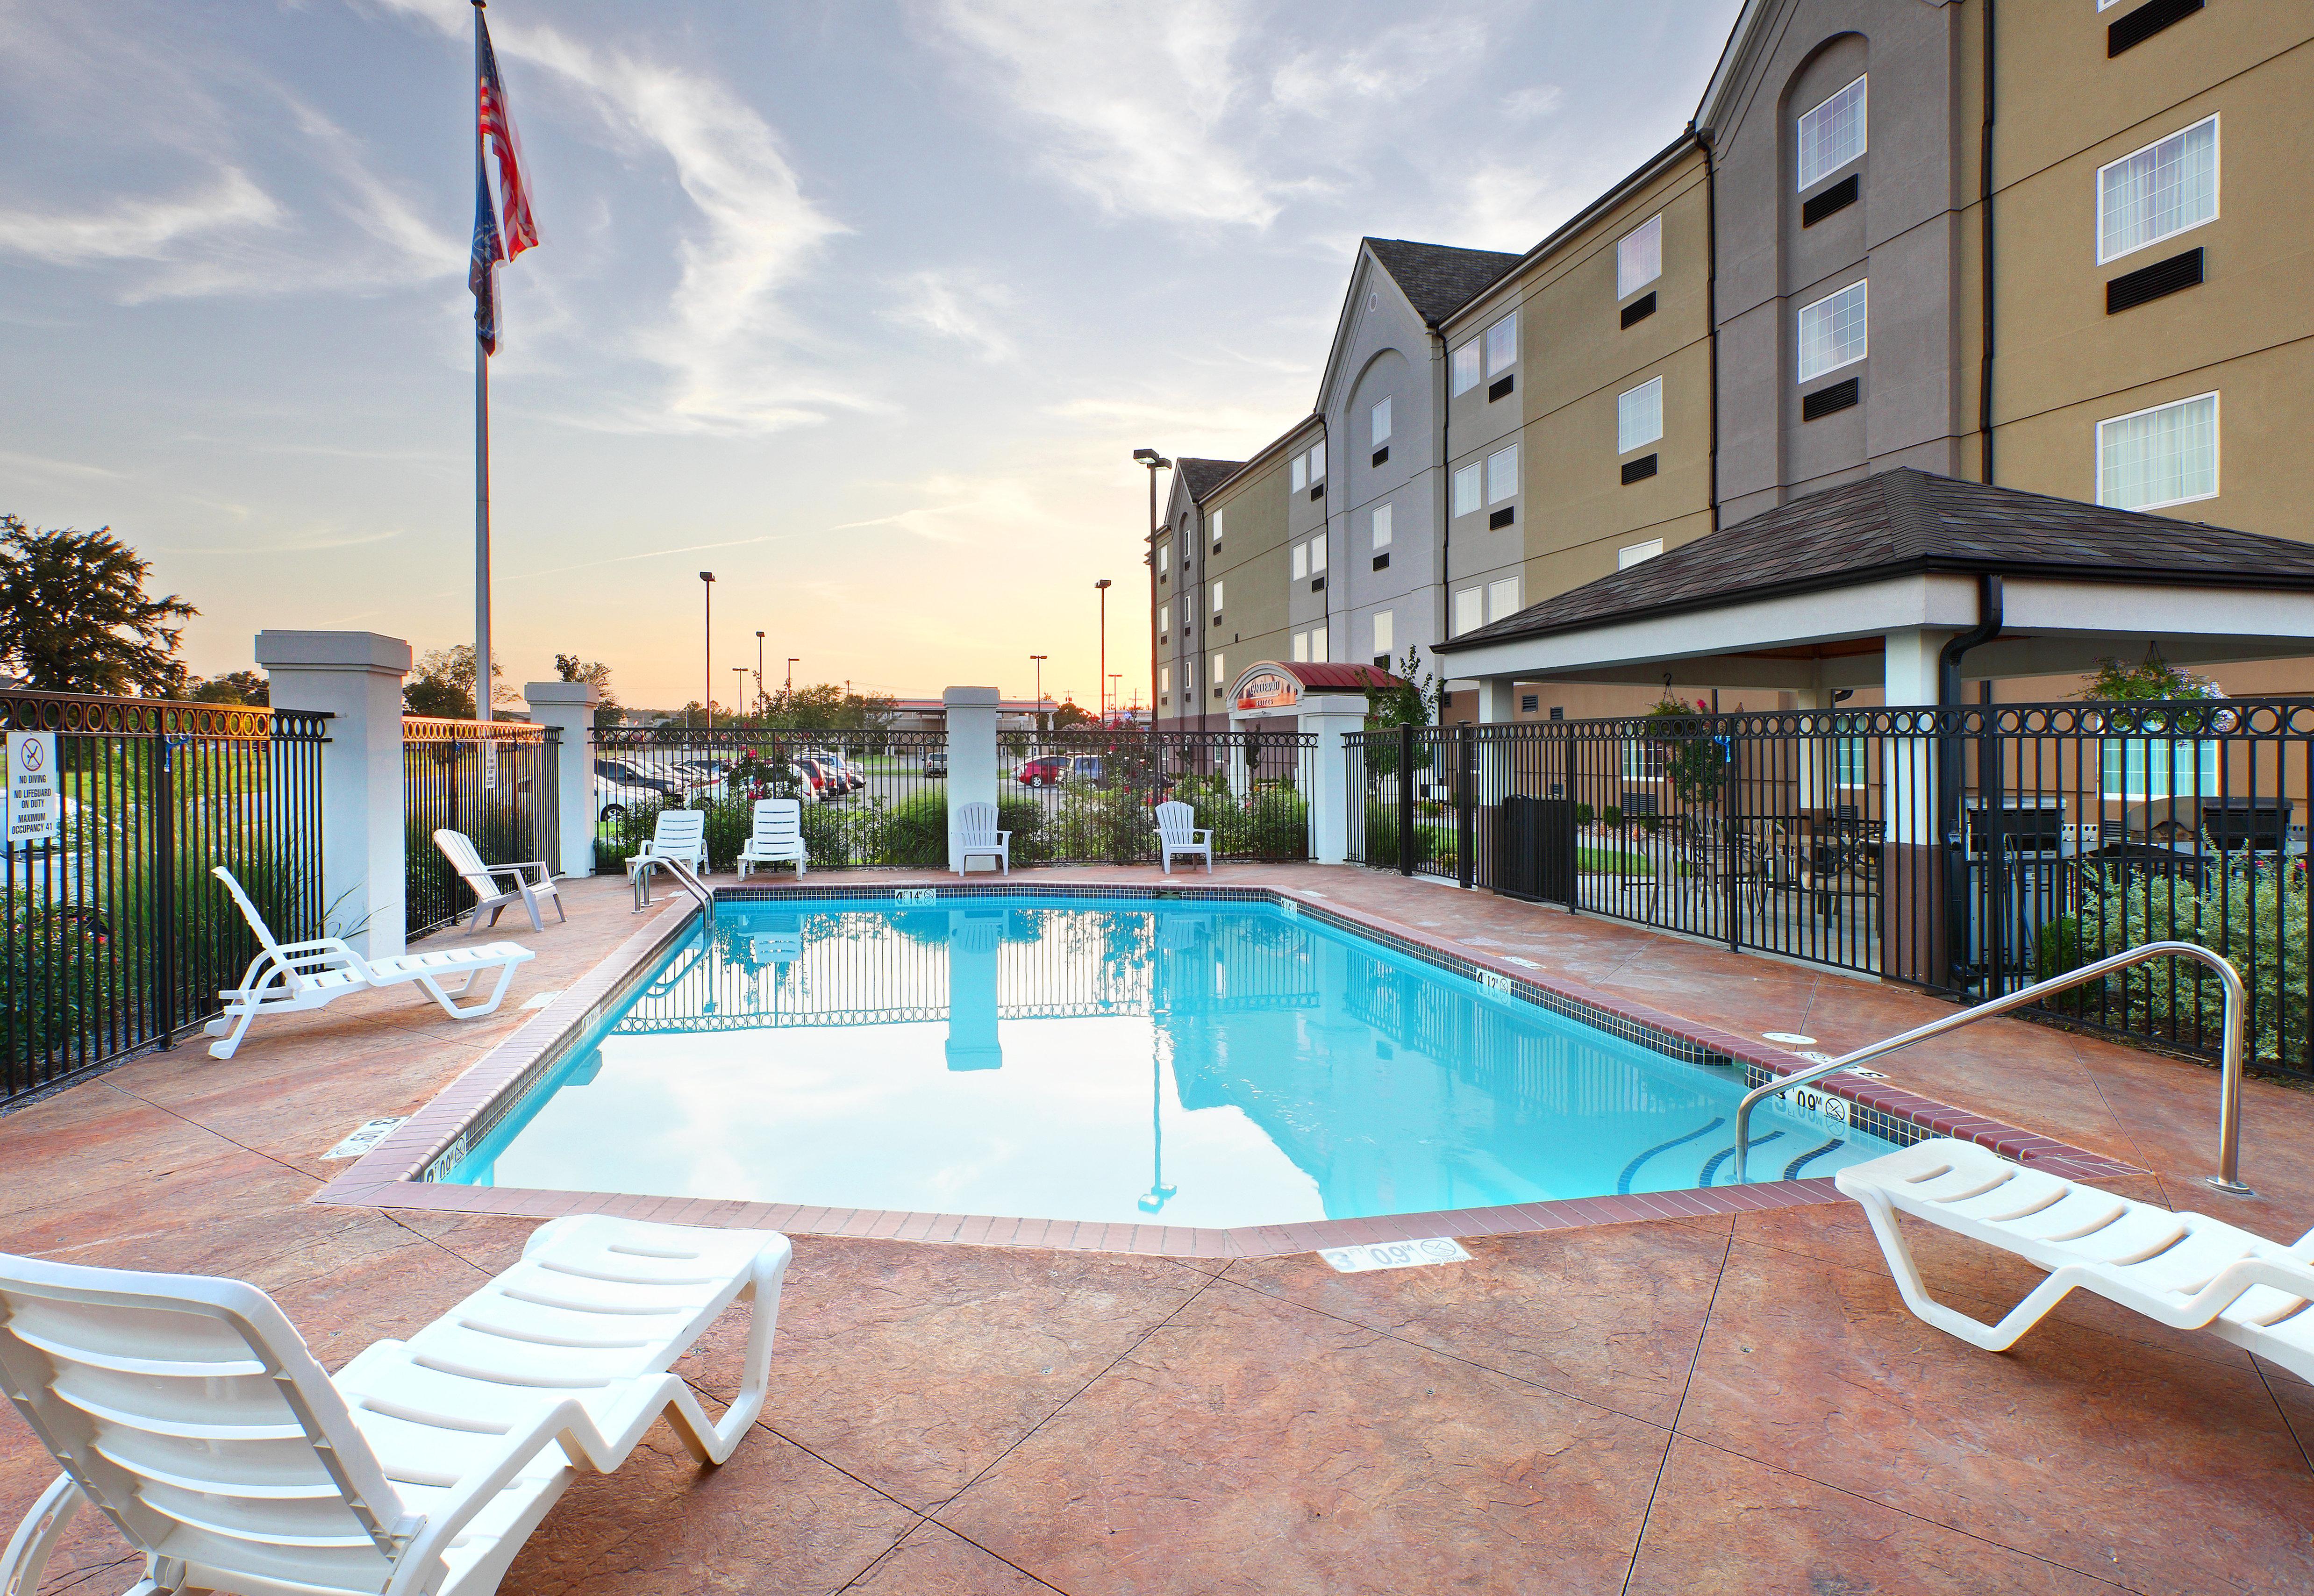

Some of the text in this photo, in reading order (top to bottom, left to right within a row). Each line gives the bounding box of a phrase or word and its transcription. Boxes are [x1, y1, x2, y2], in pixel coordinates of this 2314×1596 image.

[19, 774, 46, 784] NO DIVING
[14, 788, 51, 798] NO LIFEGUARD
[21, 799, 44, 809] ON DUTY
[18, 812, 46, 824] MAXIMUM
[12, 822, 52, 835] OCCUPANCY 41
[1477, 972, 1484, 983] 4
